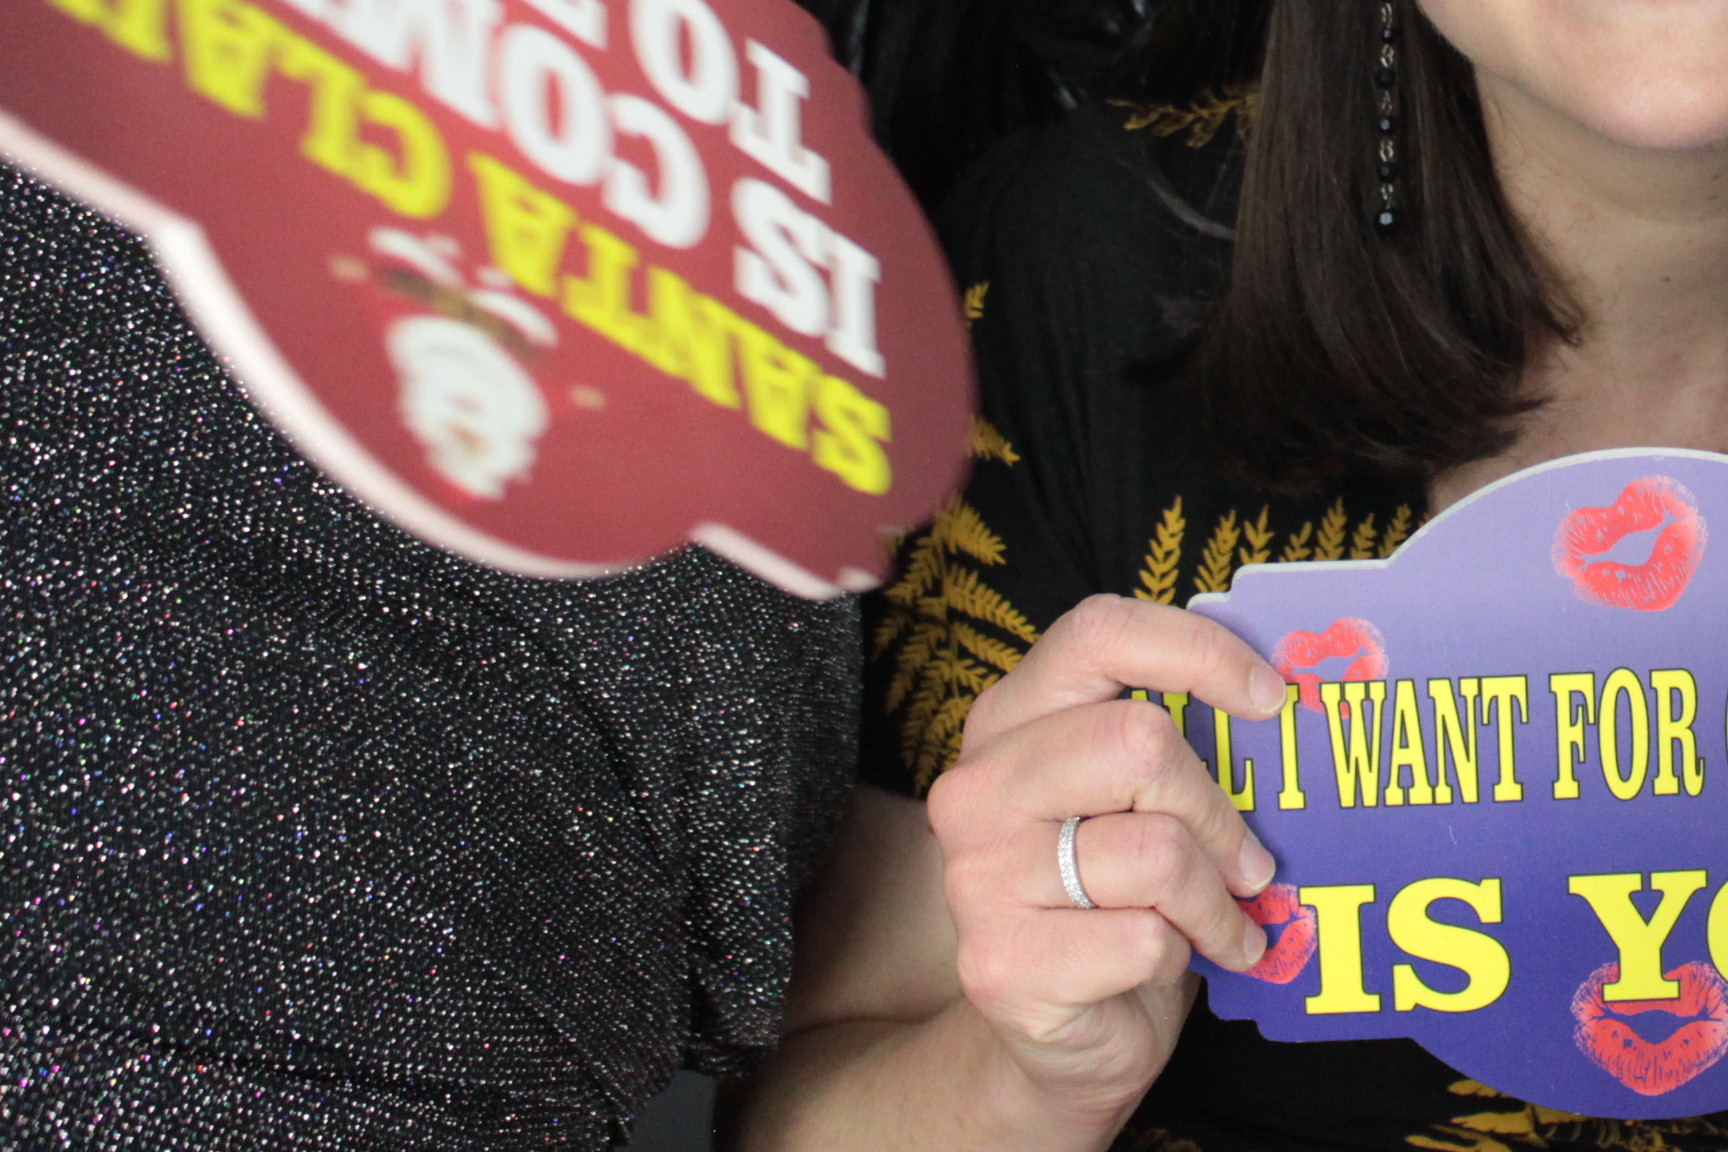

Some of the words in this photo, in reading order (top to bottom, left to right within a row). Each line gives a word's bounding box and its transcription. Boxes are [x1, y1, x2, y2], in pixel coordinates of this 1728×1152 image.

[468, 151, 892, 495] SANTA
[730, 176, 887, 378] IS
[1278, 682, 1306, 810] I
[1319, 674, 1529, 809] WANT
[1548, 666, 1706, 801] FOR
[1298, 876, 1512, 1015] IS
